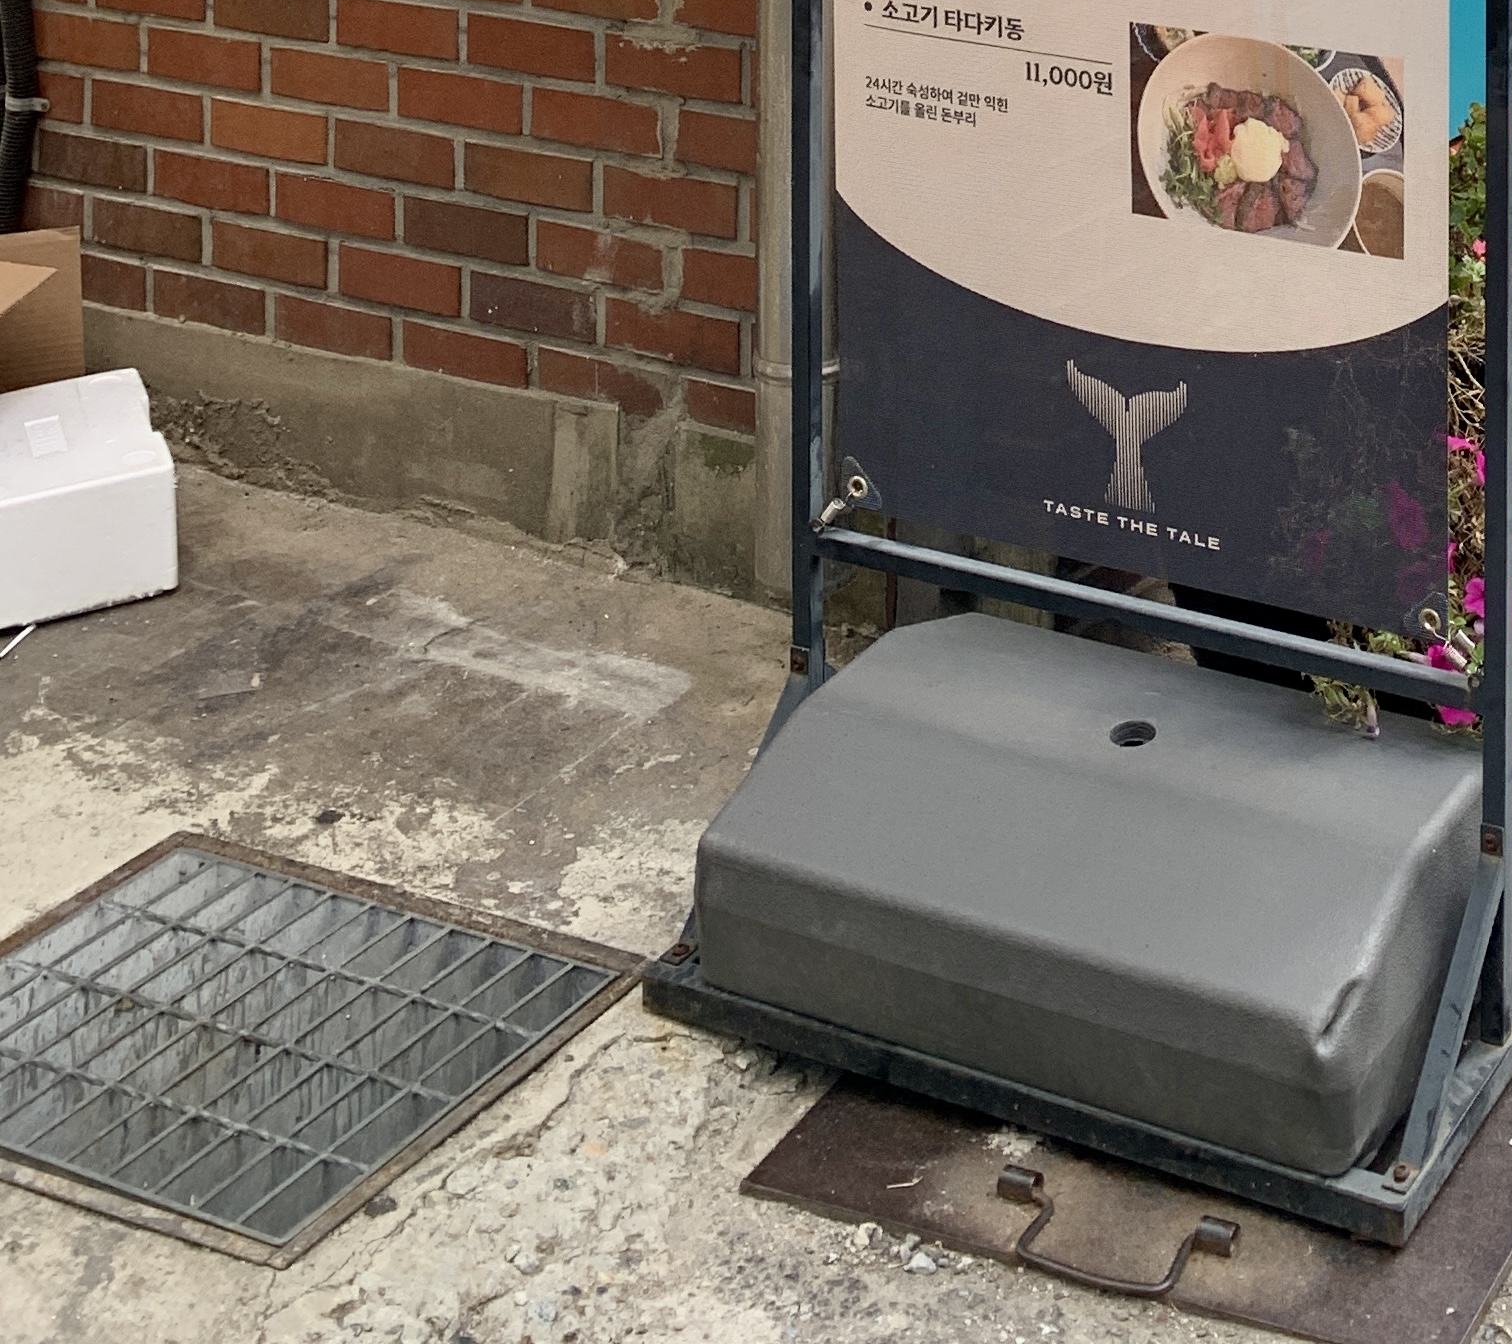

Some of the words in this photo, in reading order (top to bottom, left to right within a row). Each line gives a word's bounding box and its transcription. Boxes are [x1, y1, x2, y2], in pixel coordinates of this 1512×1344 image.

[881, 0, 939, 29] 소고기
[943, 8, 1026, 42] 타다키동
[865, 75, 903, 96] 24시간
[905, 82, 954, 105] 숙성하여
[956, 91, 982, 110] 겉만
[984, 95, 1010, 115] 익힌
[1025, 61, 1113, 97] 11,000원
[865, 94, 911, 116] 소고기를
[913, 101, 938, 121] 올린
[940, 107, 978, 128] 돈부리
[1042, 498, 1110, 526] TASTE
[1116, 515, 1159, 537] THE
[1166, 526, 1221, 551] TALE
